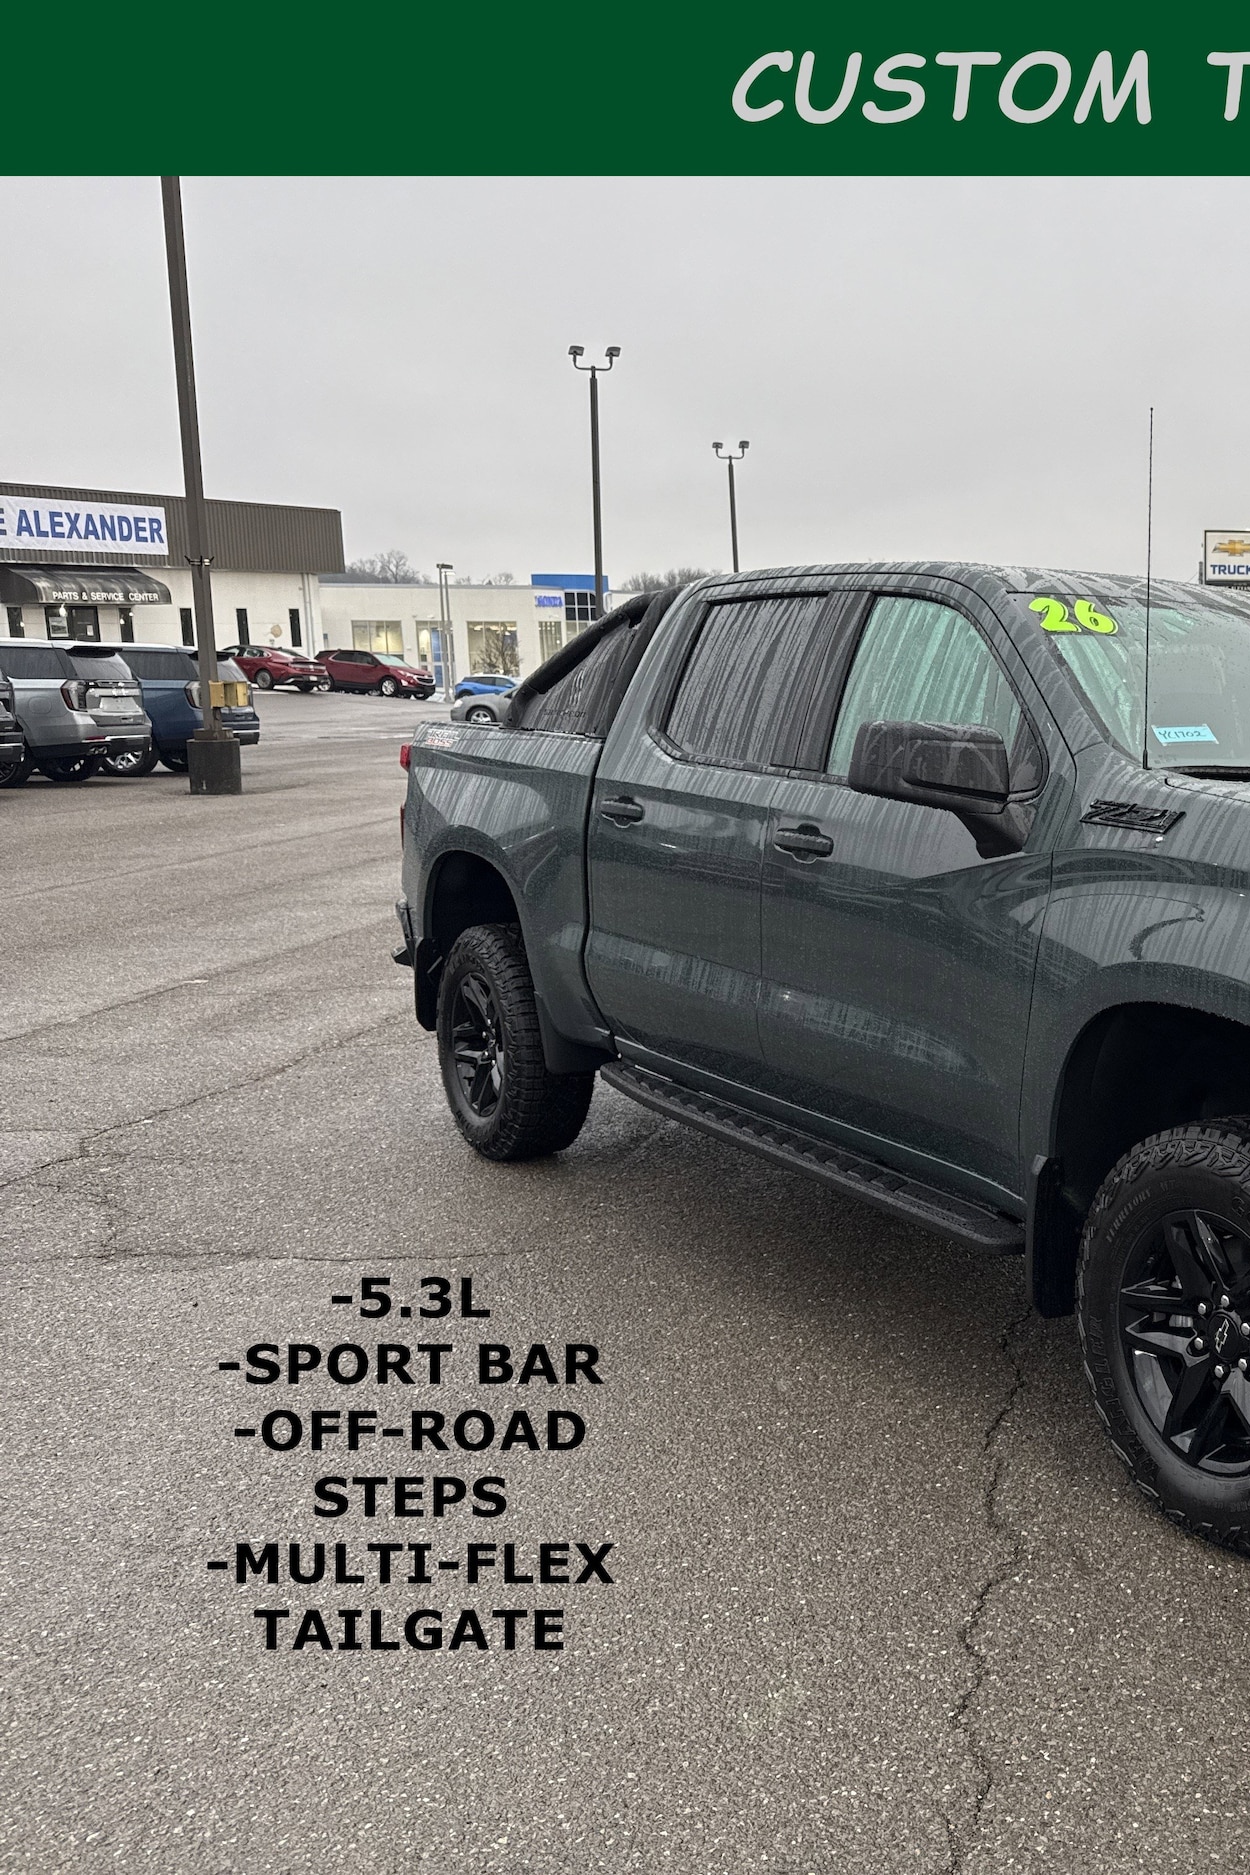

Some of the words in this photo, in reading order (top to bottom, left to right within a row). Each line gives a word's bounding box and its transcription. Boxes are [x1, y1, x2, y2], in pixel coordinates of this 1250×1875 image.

[16, 509, 165, 544] ALEXANDER
[52, 591, 79, 600] PARTS
[82, 591, 88, 600] &
[91, 592, 124, 601] SERVICE
[128, 592, 159, 601] CENTER
[1028, 597, 1119, 635] 26
